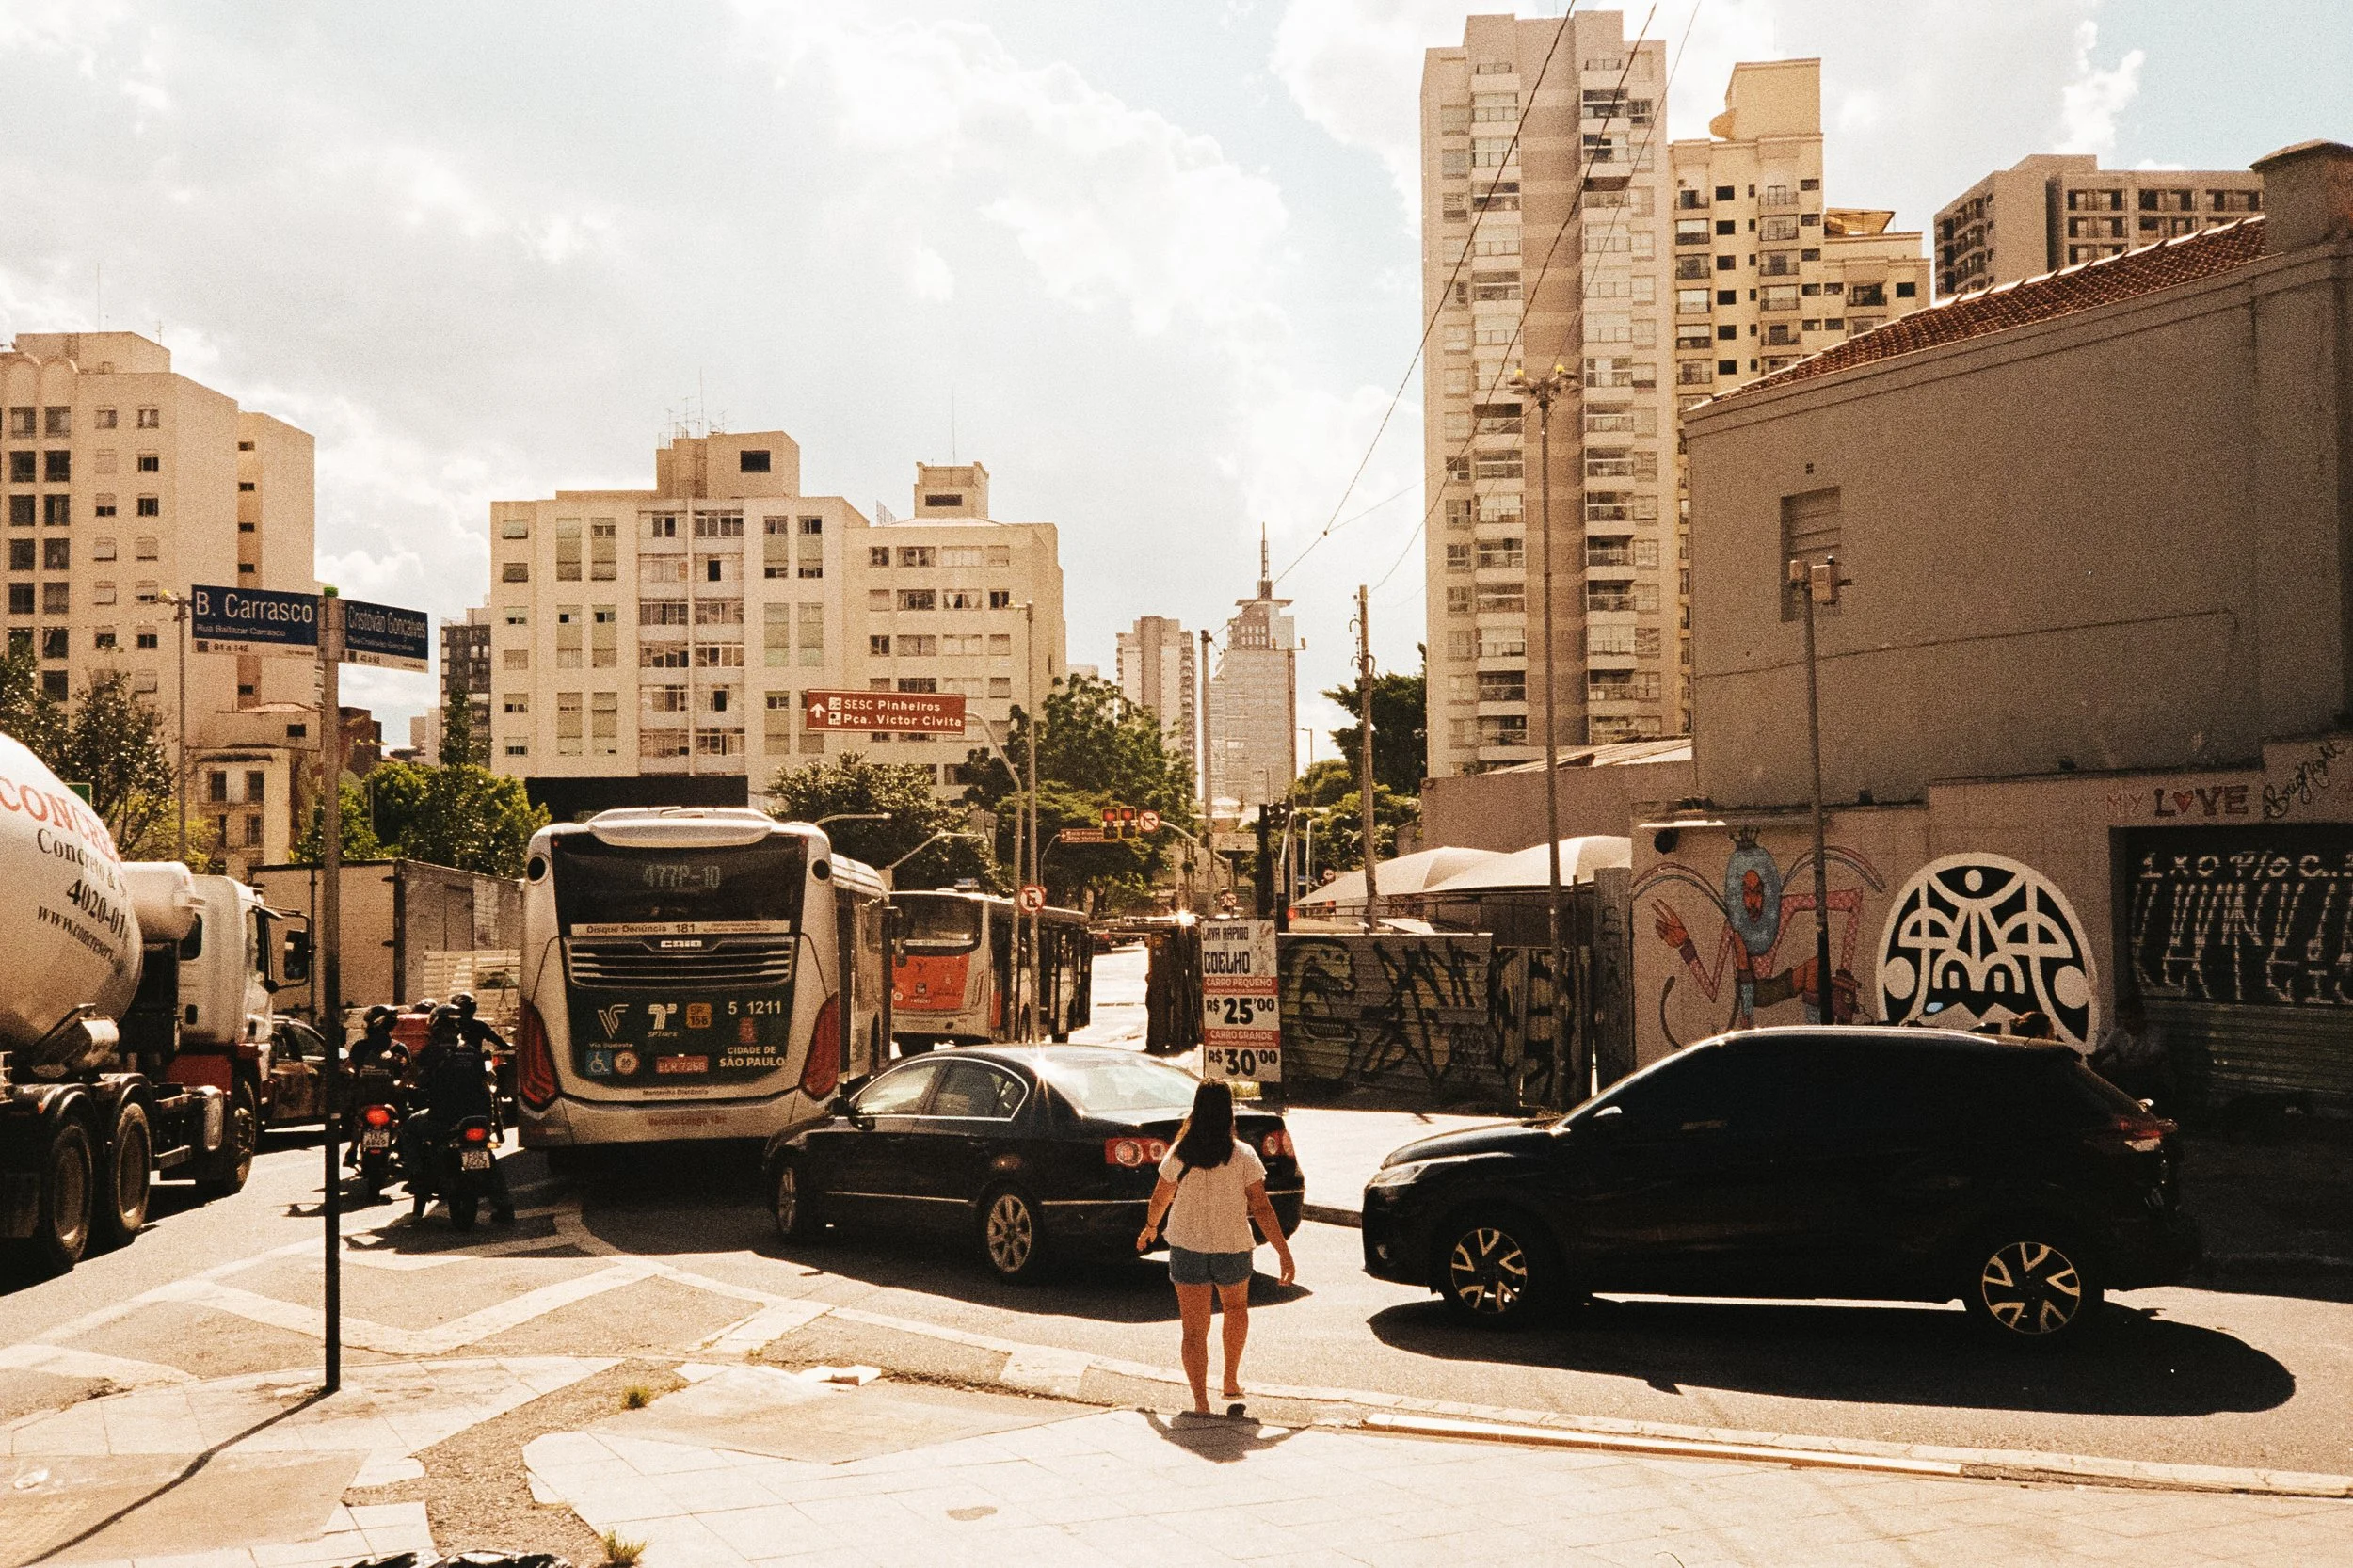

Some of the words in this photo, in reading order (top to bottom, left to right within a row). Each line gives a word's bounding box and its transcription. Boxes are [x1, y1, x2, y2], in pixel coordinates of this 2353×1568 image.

[196, 591, 216, 616] B.
[225, 593, 313, 623] Carrasco
[196, 623, 214, 633] Rua
[249, 627, 286, 637] Carrasco
[387, 611, 426, 642] Gonçalves
[843, 699, 873, 711] SESC
[877, 700, 941, 712] Pinheiros
[843, 713, 872, 726] Pça.
[876, 714, 918, 727] Victor
[922, 716, 962, 728] Civita
[37, 827, 104, 883] Concreto
[586, 925, 619, 936] Disque
[622, 924, 666, 934] Denúncia
[675, 923, 696, 933] 181
[1204, 951, 1251, 975] COELHO
[1206, 978, 1231, 986] CARRO
[1233, 978, 1273, 987] PEQUENO
[728, 1002, 737, 1015] 5
[747, 1000, 781, 1015] 1211
[1207, 998, 1220, 1015] R$
[1210, 1030, 1237, 1039] CARRO
[1238, 1031, 1273, 1040] GRANDE
[728, 1047, 761, 1055] CIDADE
[763, 1046, 776, 1054] DE
[1209, 1050, 1223, 1066] R$
[718, 1055, 744, 1067] SÃO
[746, 1057, 786, 1067] PAULO
